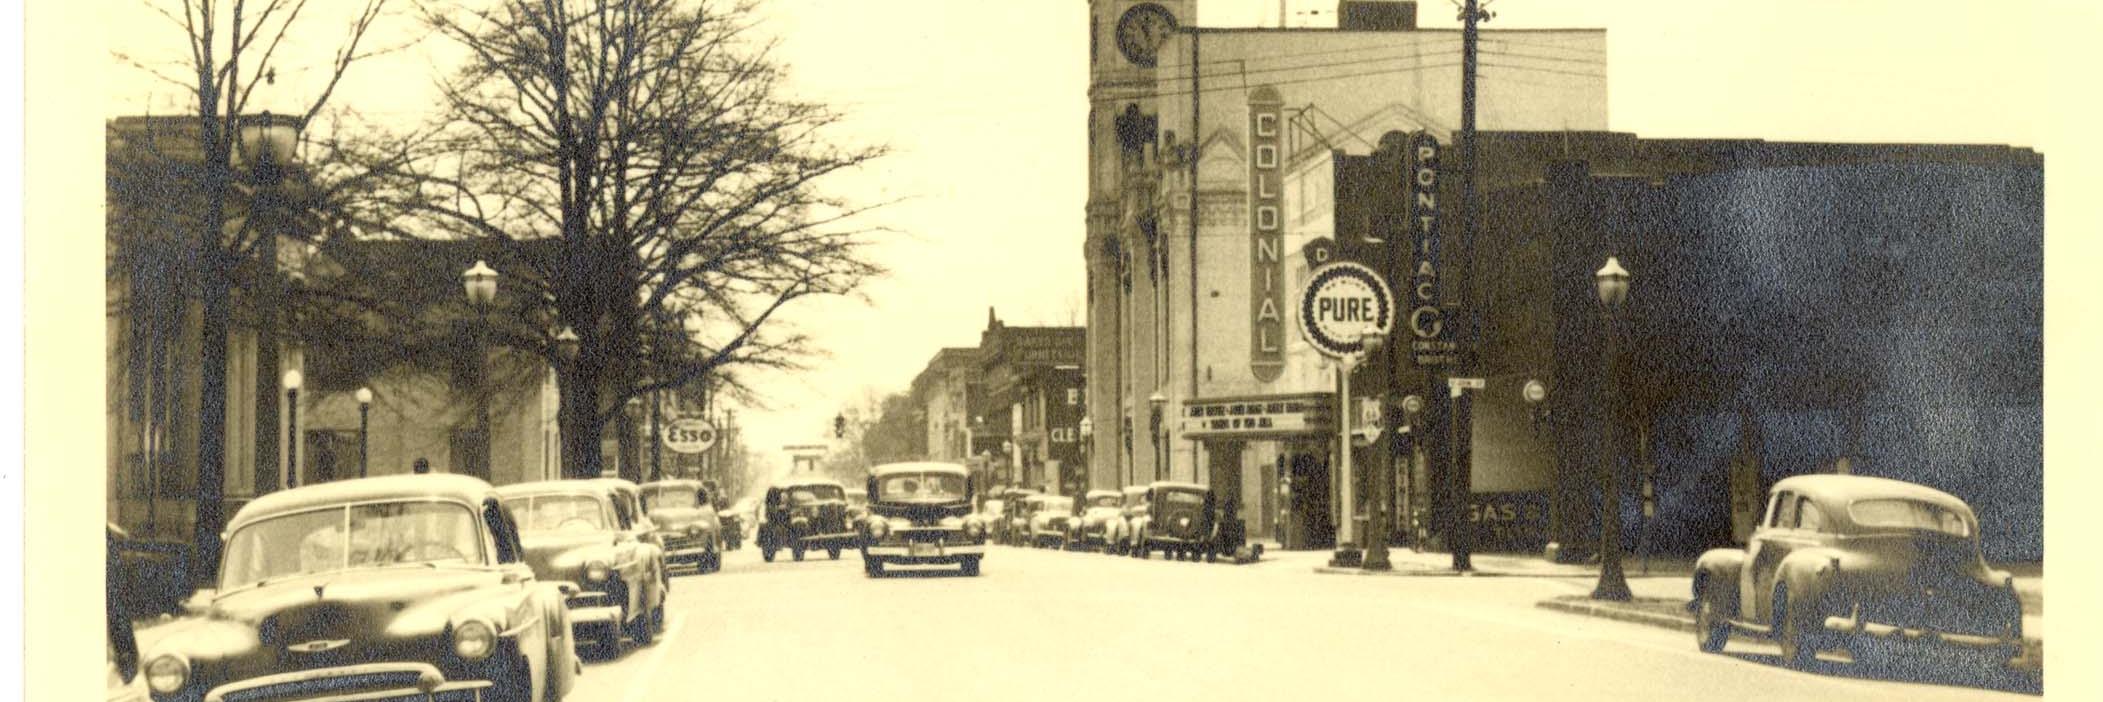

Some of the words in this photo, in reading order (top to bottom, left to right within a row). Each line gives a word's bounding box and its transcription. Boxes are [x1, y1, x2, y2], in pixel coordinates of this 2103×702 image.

[1256, 113, 1279, 352] COLONIAL
[1417, 146, 1435, 299] PONTIAC
[1318, 297, 1375, 322] PURE
